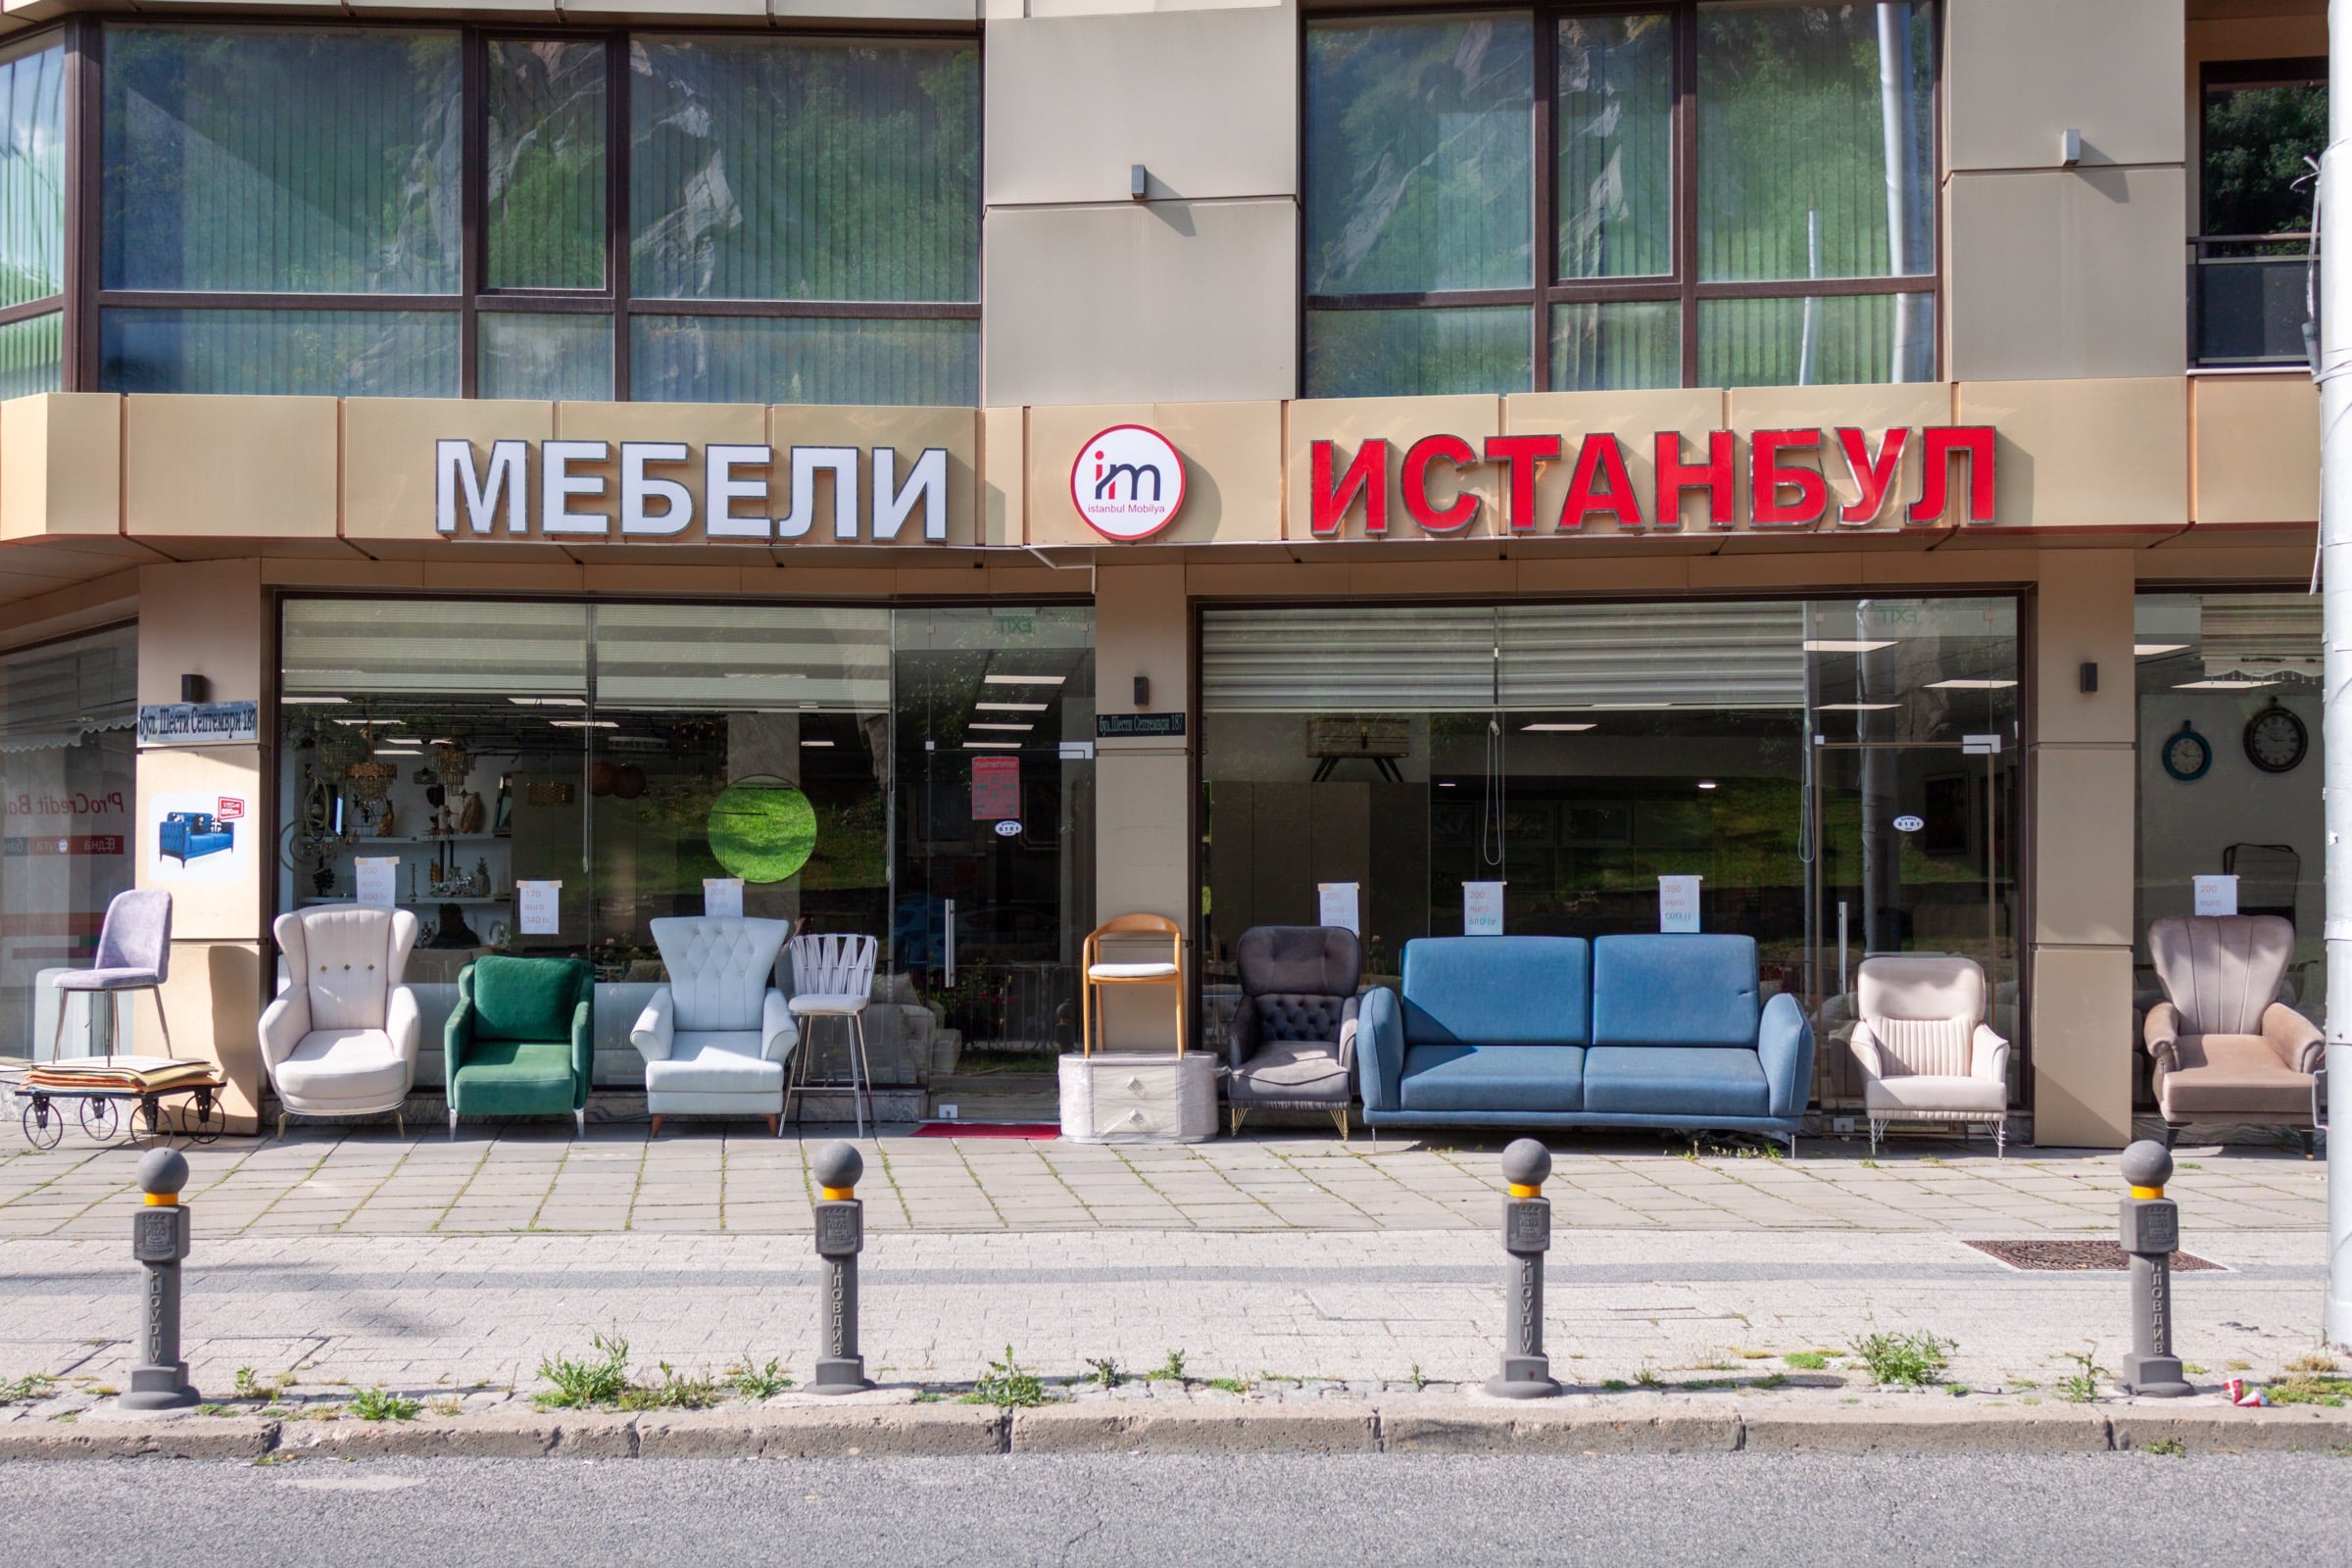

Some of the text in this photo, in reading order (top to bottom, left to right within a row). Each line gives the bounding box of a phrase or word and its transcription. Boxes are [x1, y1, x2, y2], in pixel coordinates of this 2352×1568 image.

[1095, 450, 1161, 502] im
[1309, 424, 1997, 537] ИСТАНБУЛ
[436, 438, 949, 543] МЕБЕЛИ
[1128, 504, 1165, 516] Mobilya
[139, 707, 257, 742] бул. Шести Септември 187
[1171, 713, 1183, 730] 187
[525, 889, 541, 898] 170
[1469, 891, 1485, 900] 200
[1664, 885, 1682, 894] 350
[2200, 885, 2218, 894] 200
[1664, 899, 1686, 907] euro
[2199, 899, 2222, 907] euro
[524, 915, 541, 924] 340
[831, 1261, 844, 1356] ПЛОВДИВ
[1521, 1258, 1533, 1355] PLOVDIV
[2150, 1260, 2165, 1355] ПЛОВДИВ
[150, 1269, 162, 1365] PLOVDIV
